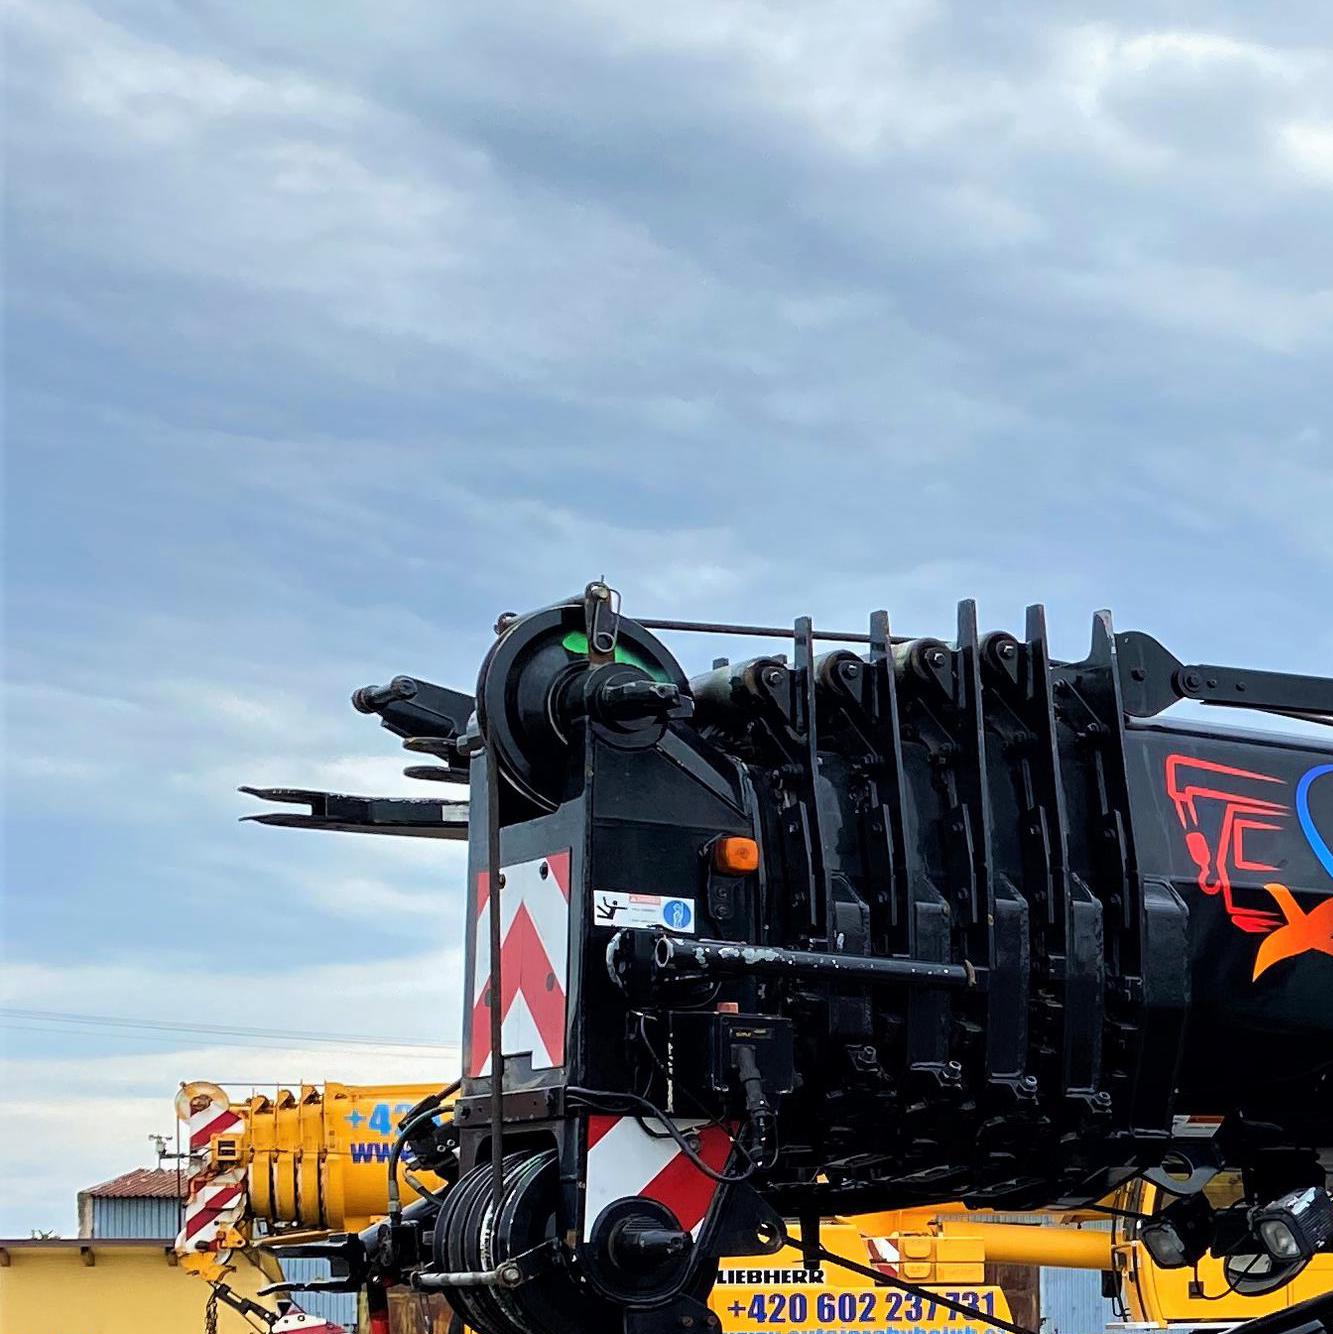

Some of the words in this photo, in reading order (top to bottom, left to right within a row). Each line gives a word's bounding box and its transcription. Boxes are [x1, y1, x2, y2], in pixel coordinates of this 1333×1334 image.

[716, 1269, 825, 1284] LIEBHERR
[727, 1292, 808, 1323] +420
[816, 1292, 876, 1323] 602
